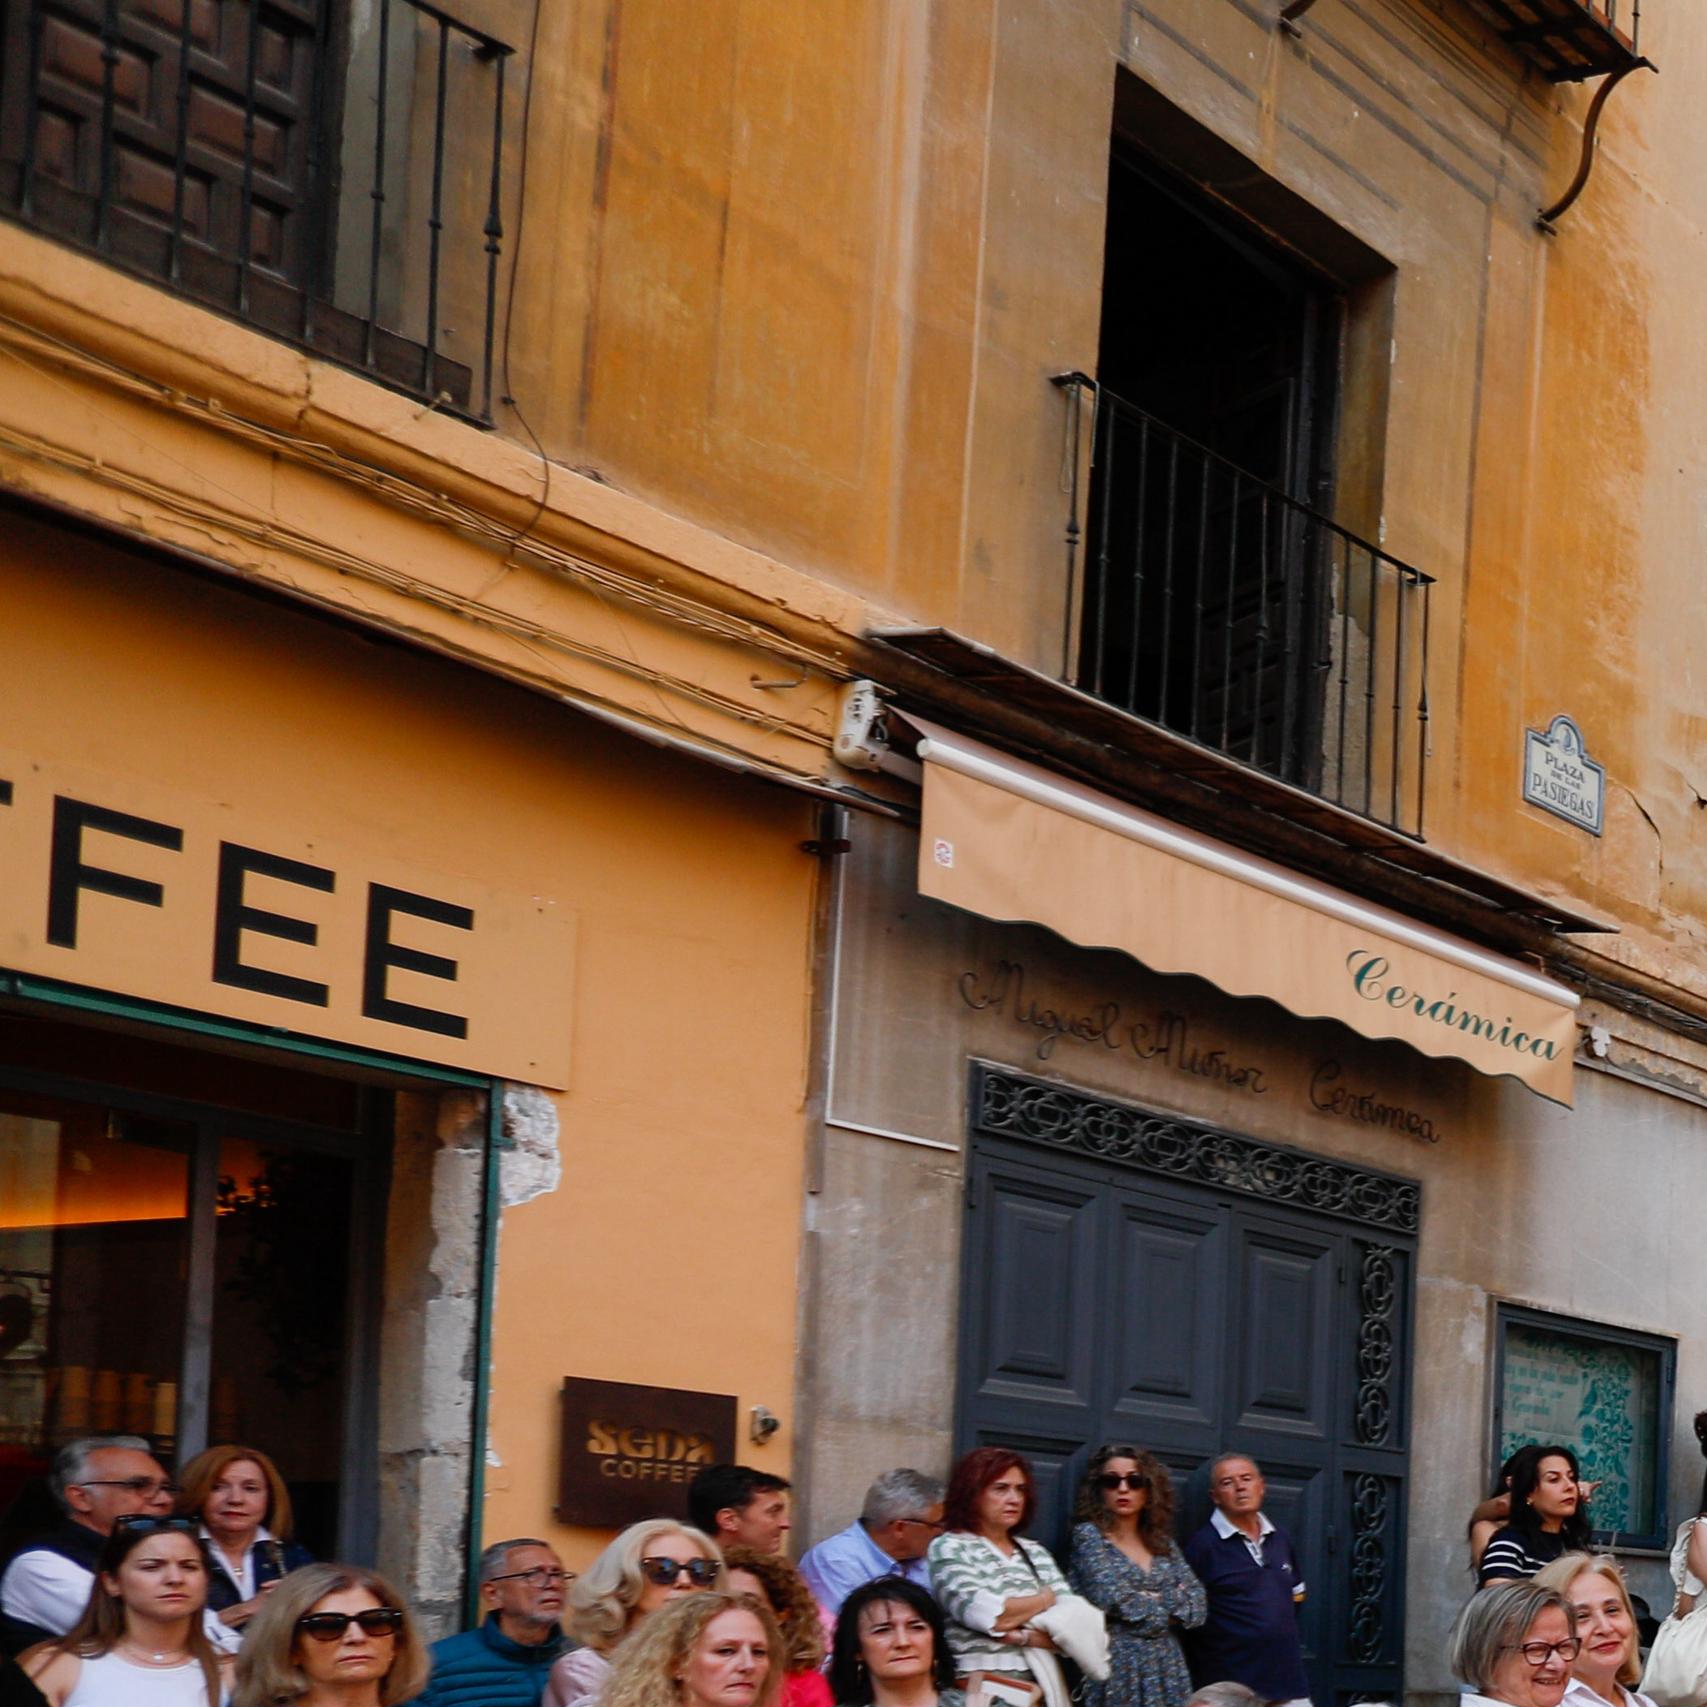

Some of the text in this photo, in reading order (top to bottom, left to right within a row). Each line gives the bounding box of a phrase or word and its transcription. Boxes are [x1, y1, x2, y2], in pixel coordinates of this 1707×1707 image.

[1532, 772, 1594, 819] PASIEGAS
[1545, 751, 1585, 784] PLAZA
[0, 779, 474, 1040] FEE
[1346, 950, 1564, 1061] Cerámica
